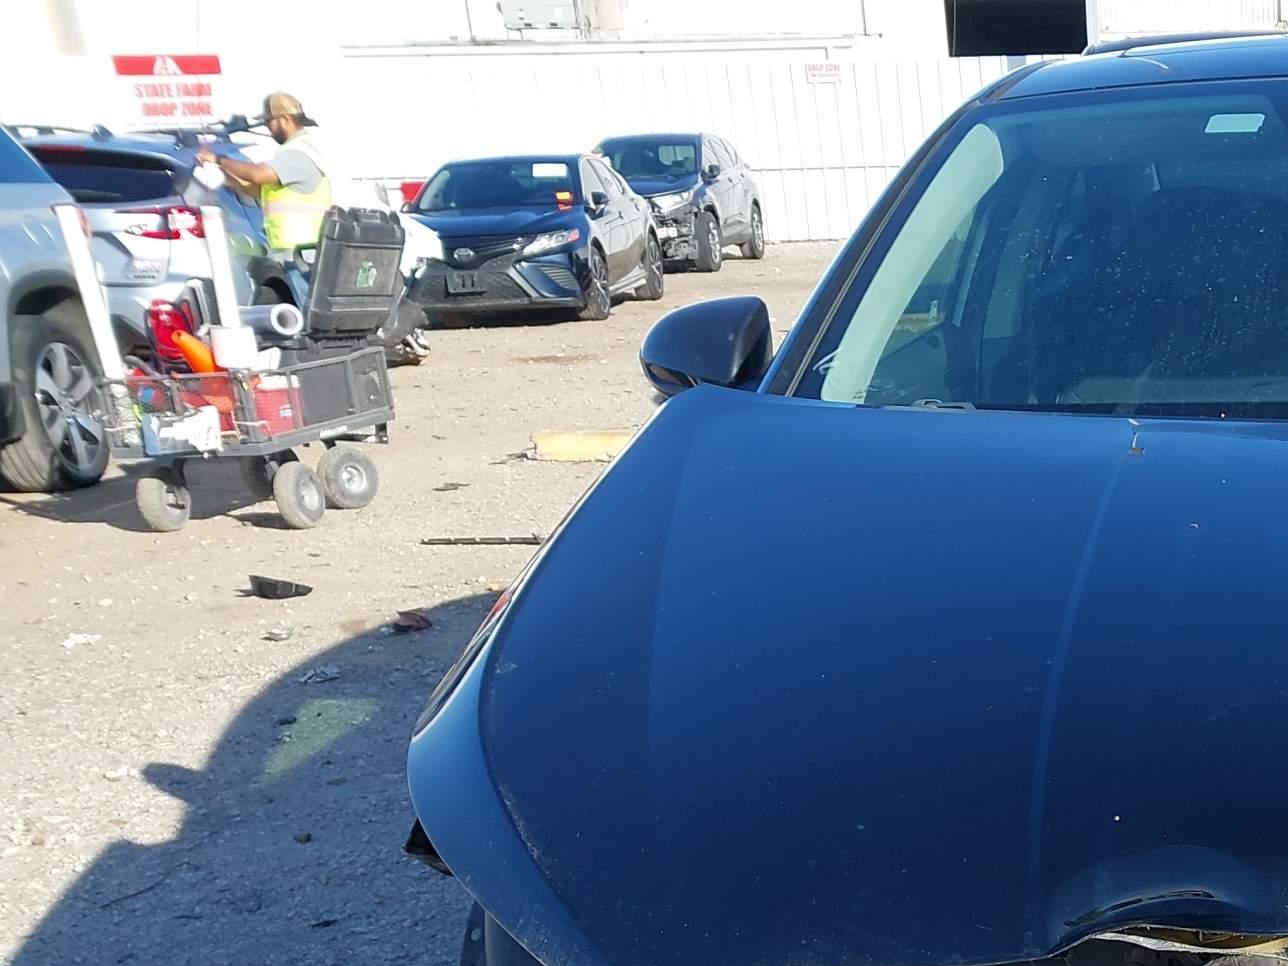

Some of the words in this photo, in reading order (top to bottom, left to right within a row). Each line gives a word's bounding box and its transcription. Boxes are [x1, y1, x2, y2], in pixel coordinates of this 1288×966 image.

[134, 83, 174, 98] STATE
[142, 102, 177, 117] DROP
[181, 102, 213, 116] ZONE
